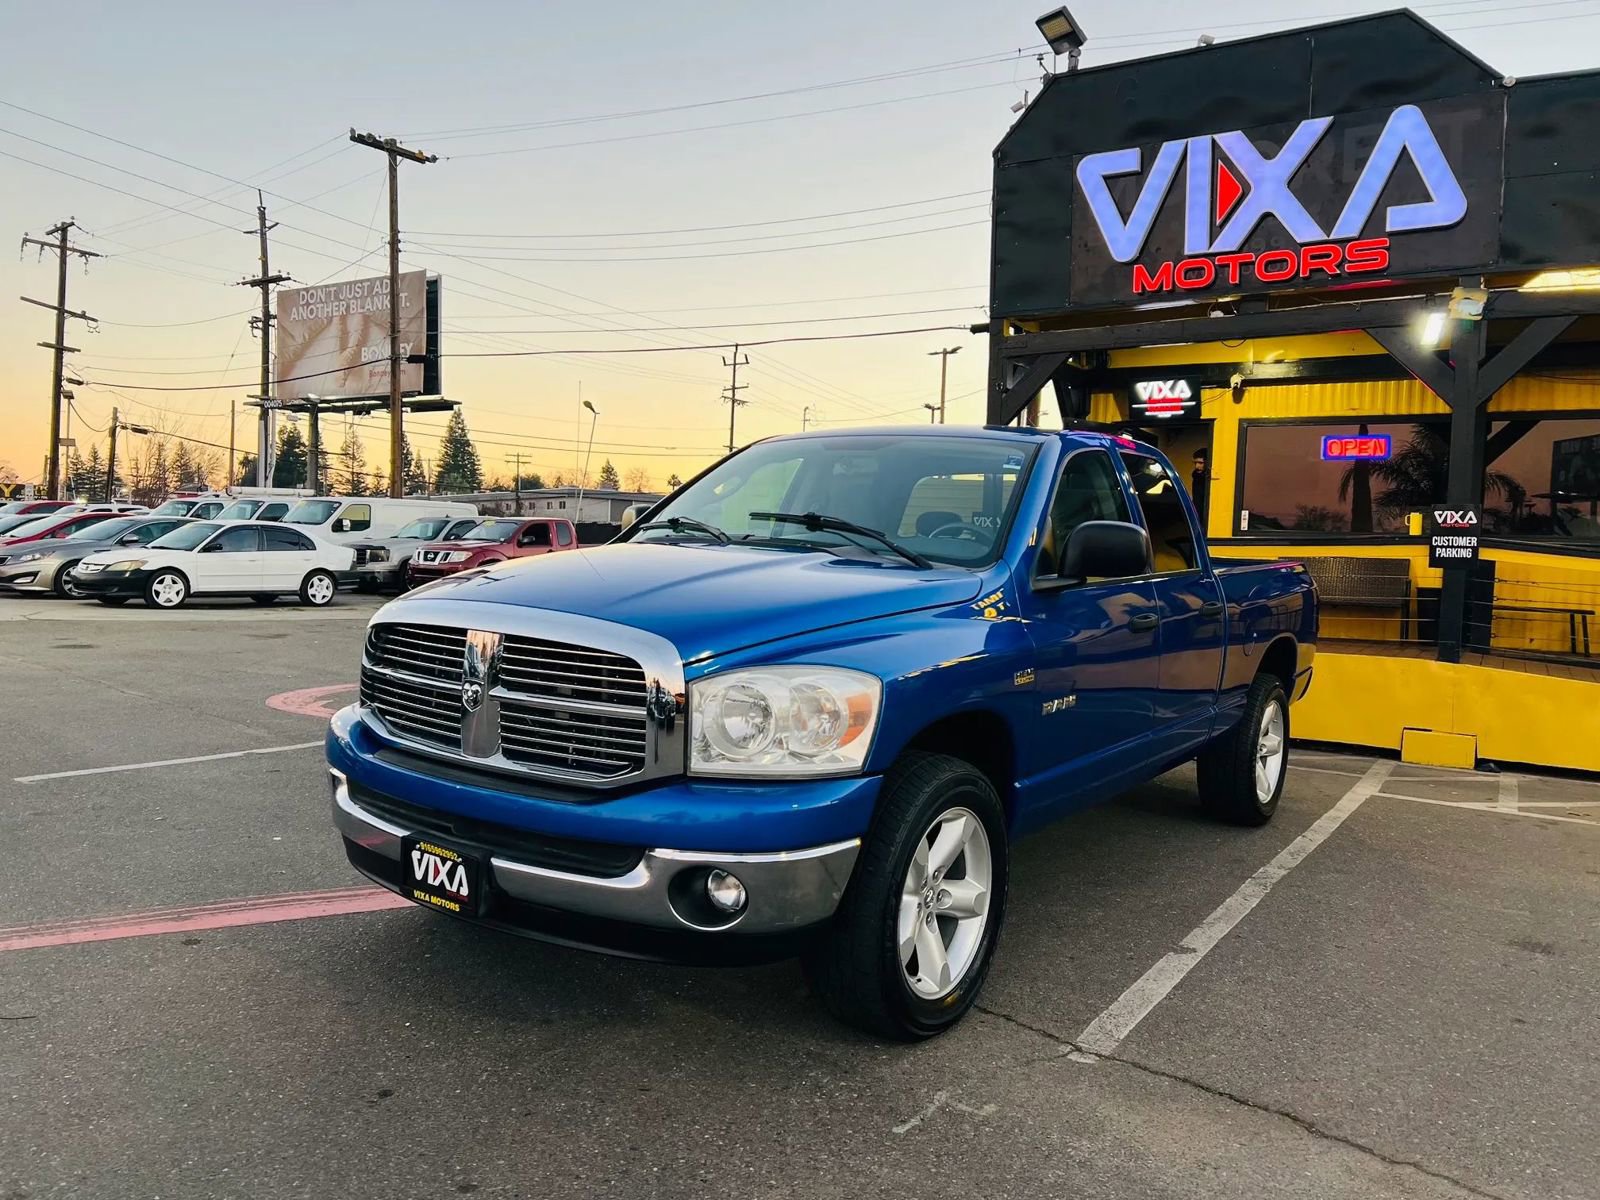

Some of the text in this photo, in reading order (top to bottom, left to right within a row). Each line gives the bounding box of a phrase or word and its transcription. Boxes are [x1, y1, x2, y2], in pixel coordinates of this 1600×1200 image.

[1076, 104, 1468, 263] VIXA
[1132, 237, 1390, 294] MOTORS
[300, 278, 400, 305] DON'T JUST AD
[290, 292, 410, 321] ANOTHER BLANKT.
[1134, 379, 1193, 402] VIXA
[1327, 438, 1386, 457] OPEN
[1434, 510, 1478, 524] VIXA
[1432, 536, 1478, 547] CUSTOMER
[1435, 547, 1473, 558] PARKING
[411, 850, 469, 896] VIXA
[413, 889, 430, 902] VIXA
[431, 895, 460, 912] MOTORS
